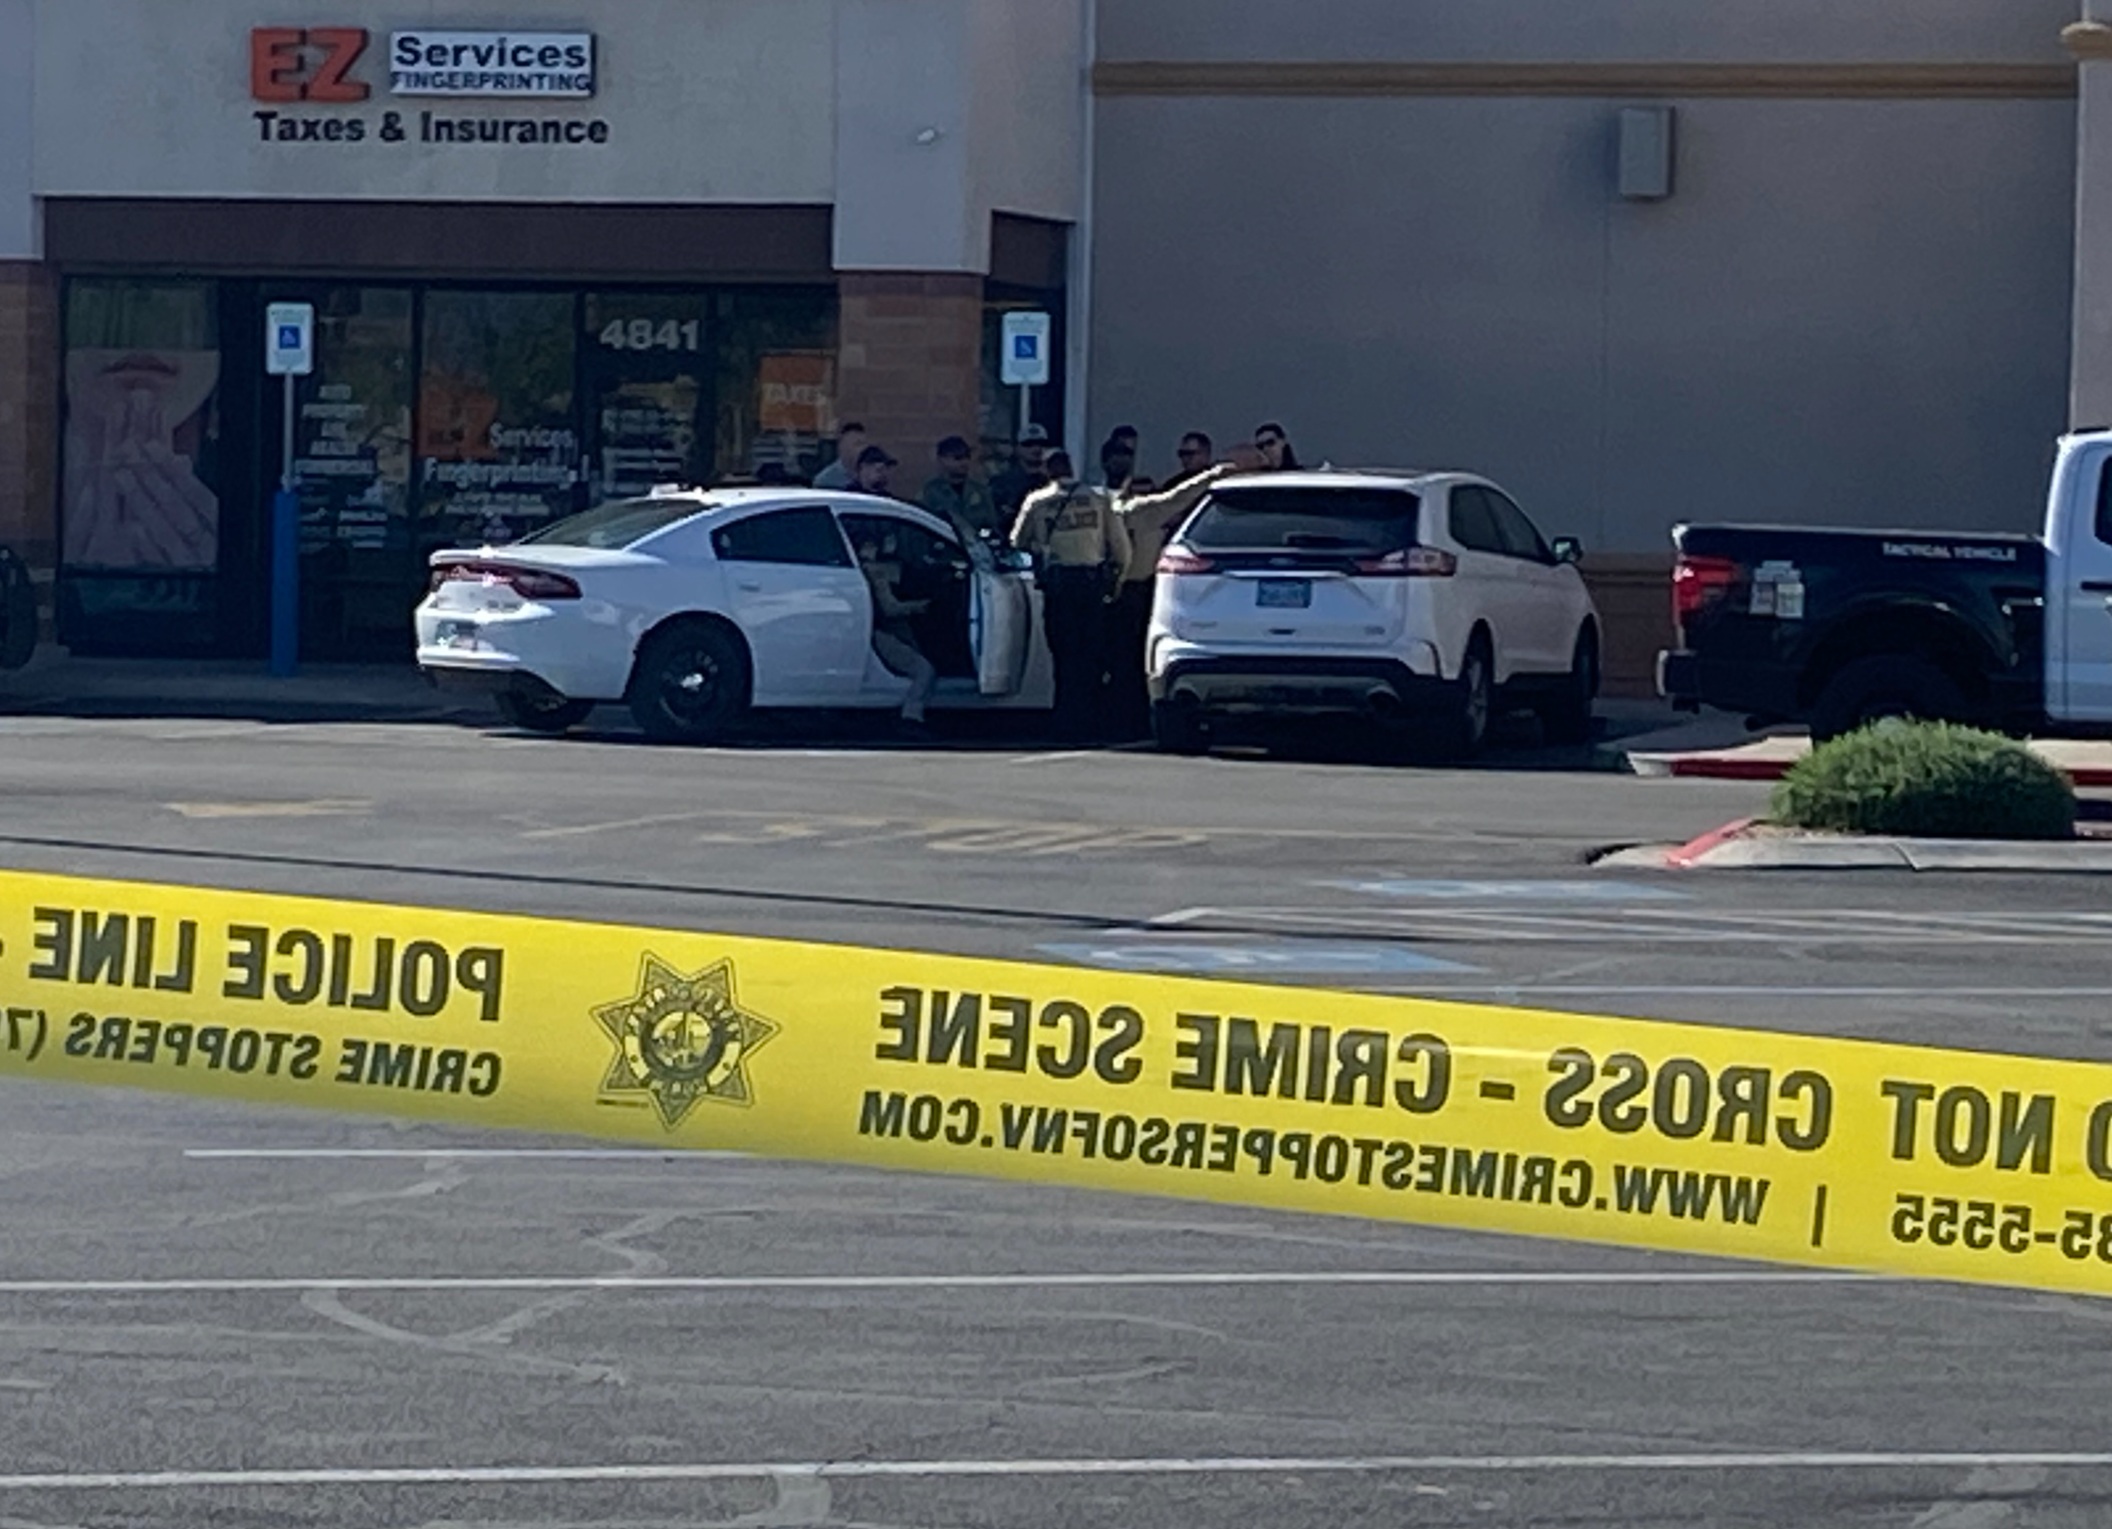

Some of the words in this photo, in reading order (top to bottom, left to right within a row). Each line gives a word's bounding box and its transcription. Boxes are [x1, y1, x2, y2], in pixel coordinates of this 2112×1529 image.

[251, 27, 370, 101] EZ
[395, 36, 587, 68] Services
[391, 71, 592, 92] FINGERPRINTING
[254, 111, 365, 142] Taxes
[380, 111, 406, 142] &
[421, 112, 609, 144] Insurance
[600, 319, 699, 350] 4841
